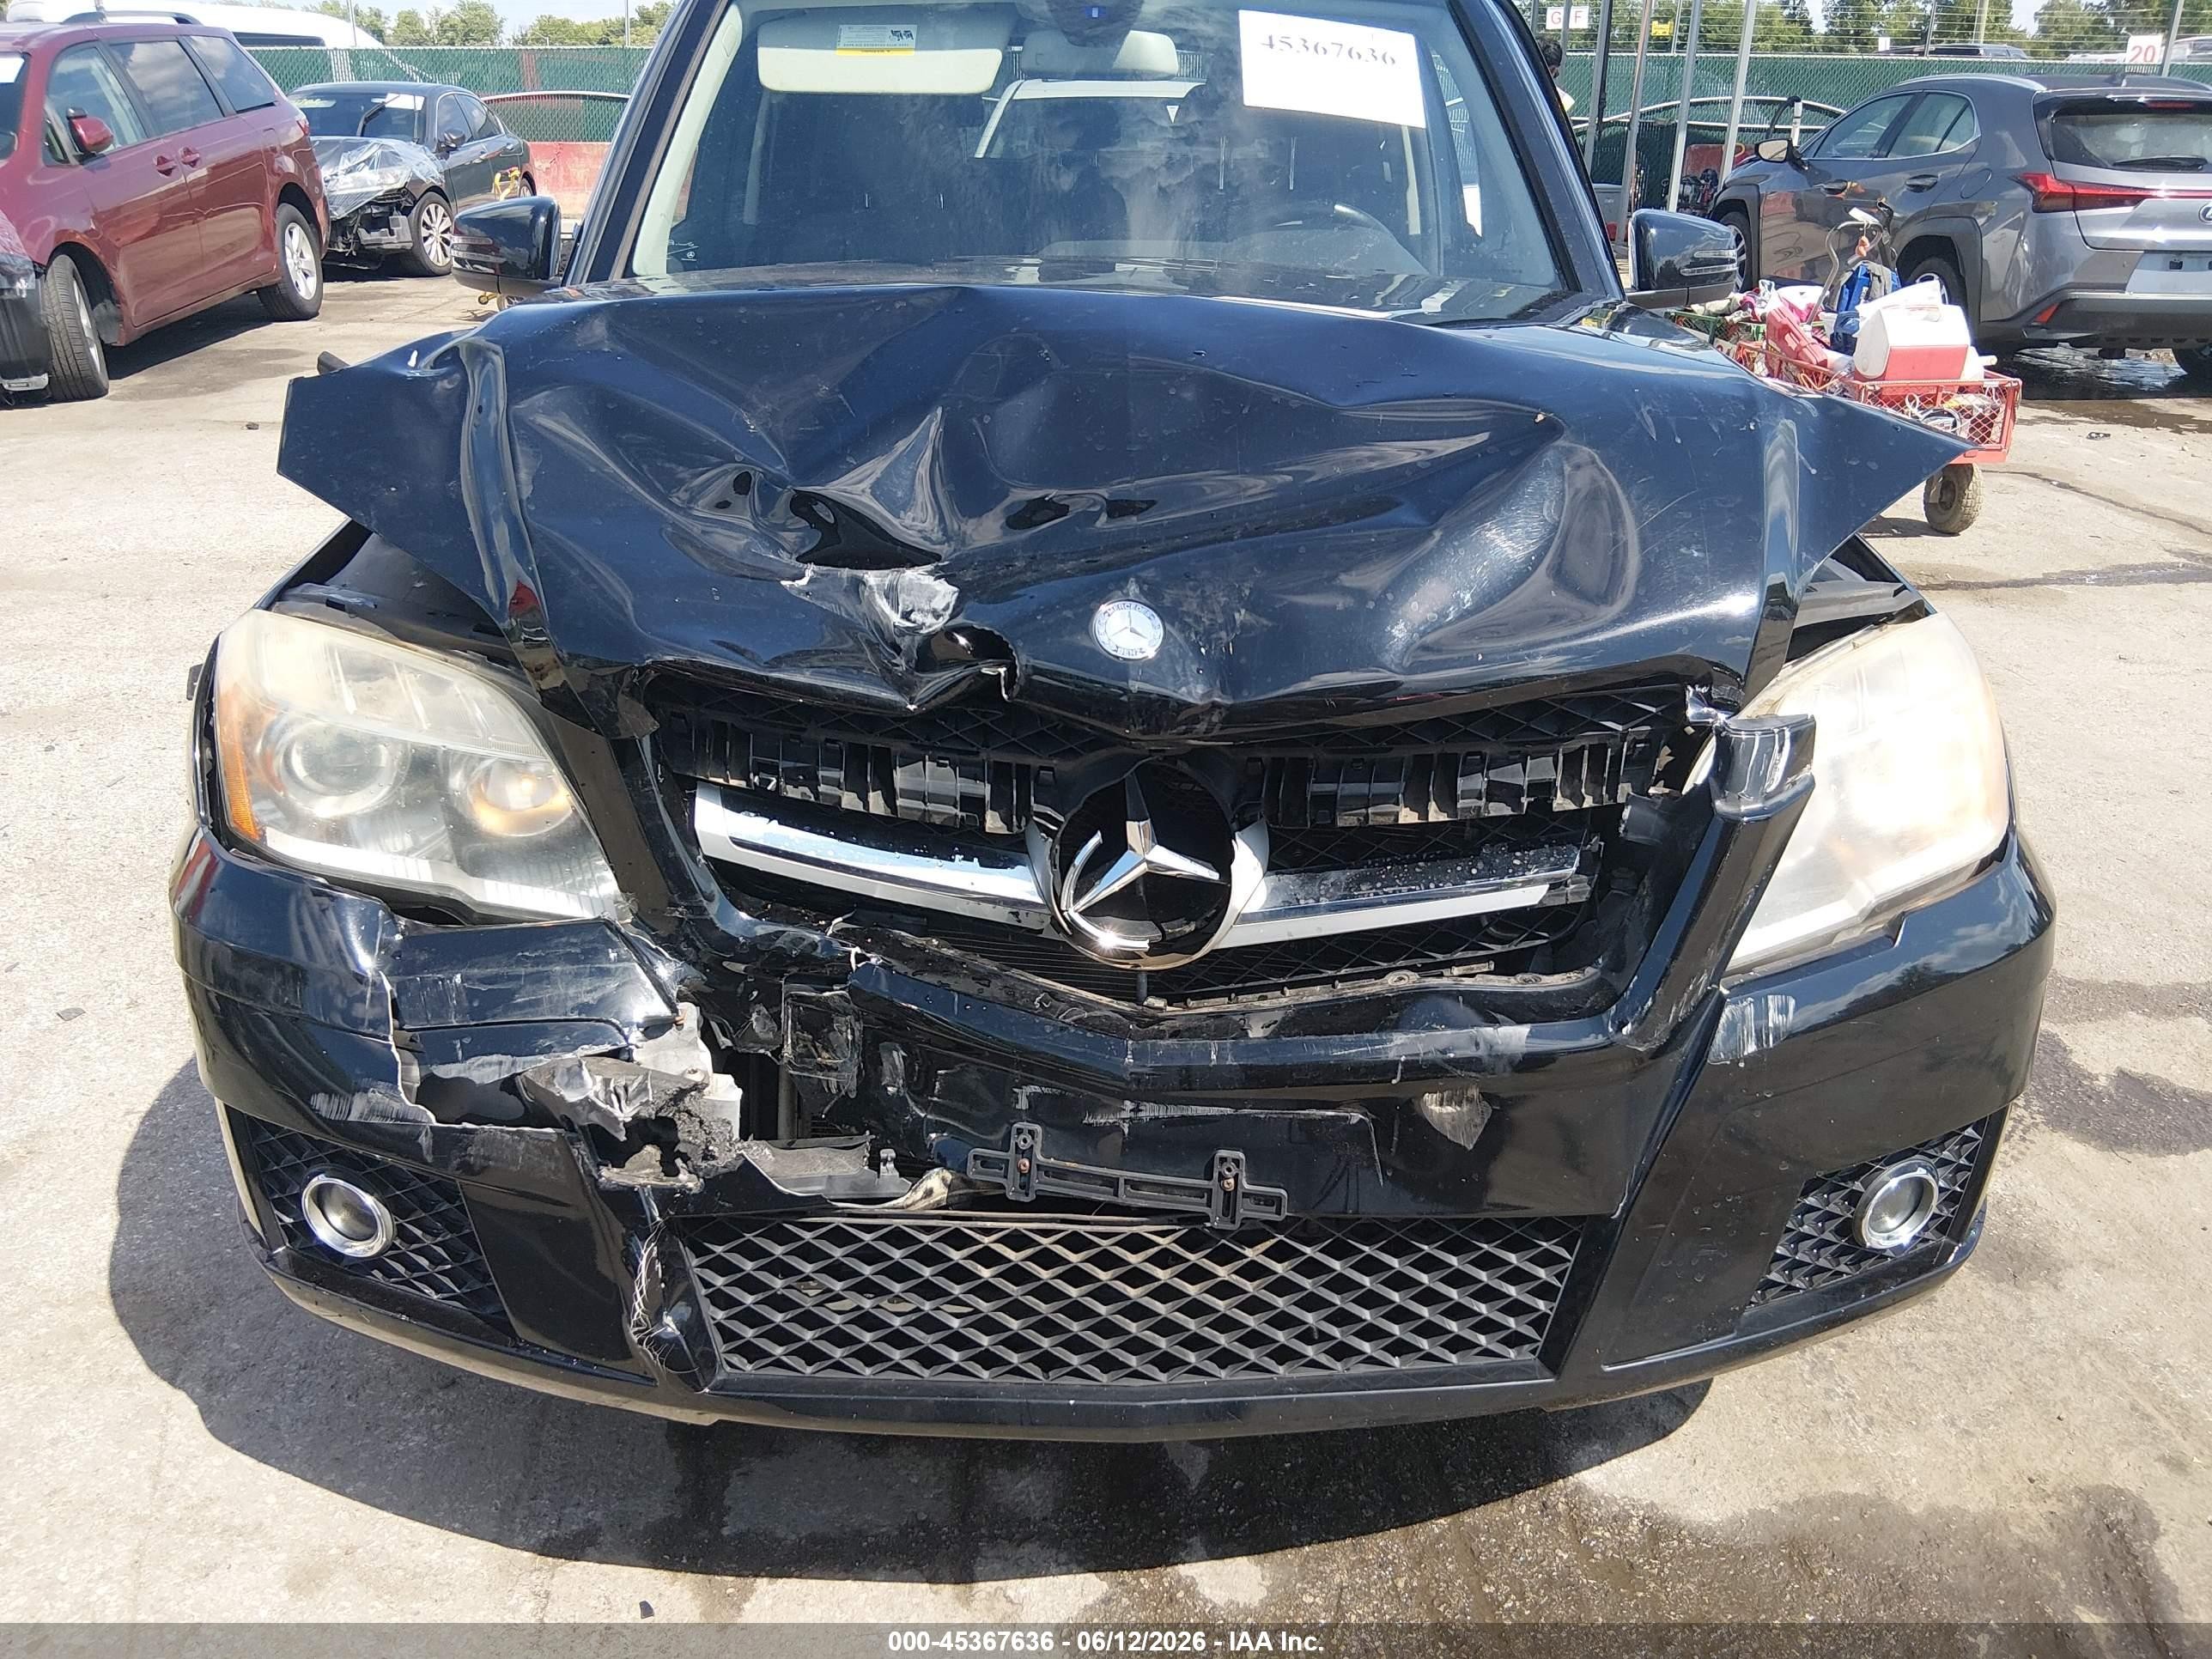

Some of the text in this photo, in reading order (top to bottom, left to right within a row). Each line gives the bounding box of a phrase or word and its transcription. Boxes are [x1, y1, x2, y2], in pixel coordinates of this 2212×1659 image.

[1551, 11, 1562, 25] G
[1575, 10, 1583, 24] F
[1261, 33, 1397, 66] 45367636
[2130, 45, 2156, 63] 20
